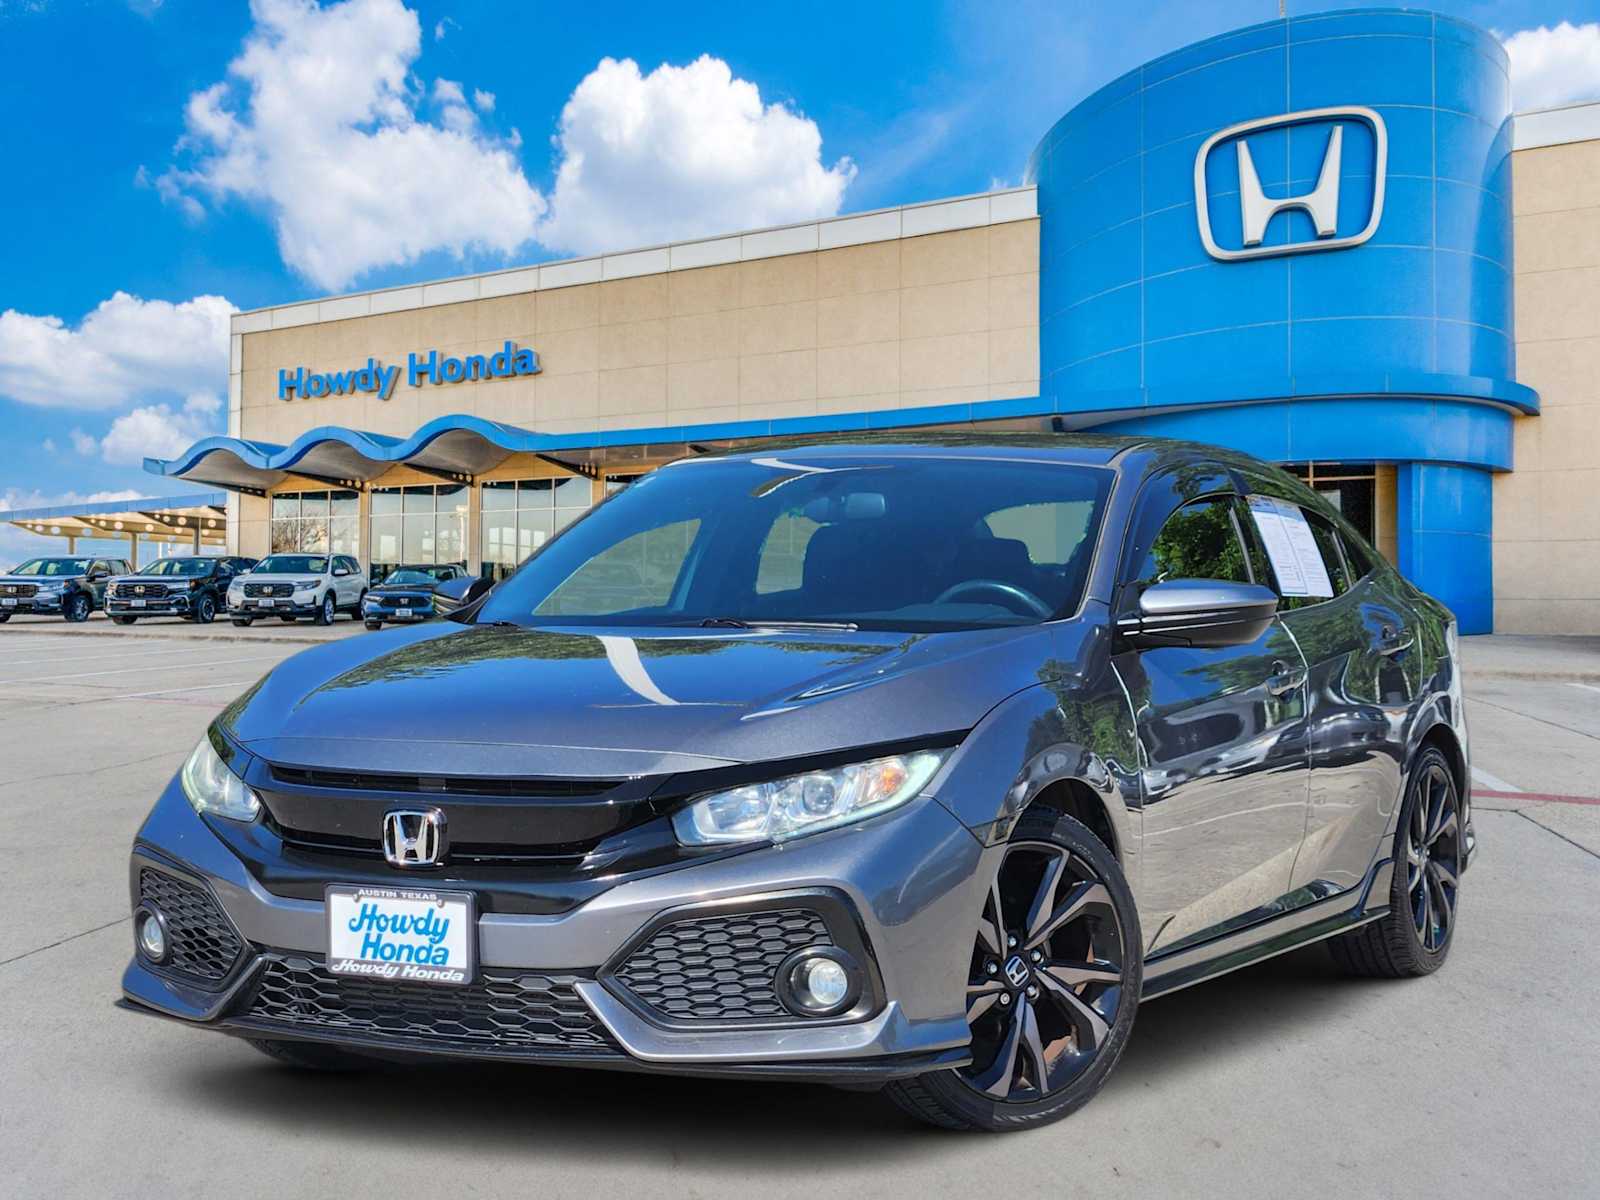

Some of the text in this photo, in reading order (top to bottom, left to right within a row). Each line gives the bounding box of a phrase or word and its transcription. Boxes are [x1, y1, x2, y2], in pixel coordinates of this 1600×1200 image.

[278, 341, 542, 400] Howdy Honda
[358, 889, 438, 900] AUSTIN TEXAS
[349, 903, 450, 944] Howdy
[360, 933, 450, 965] Honda
[331, 960, 464, 982] Howdy Honda
